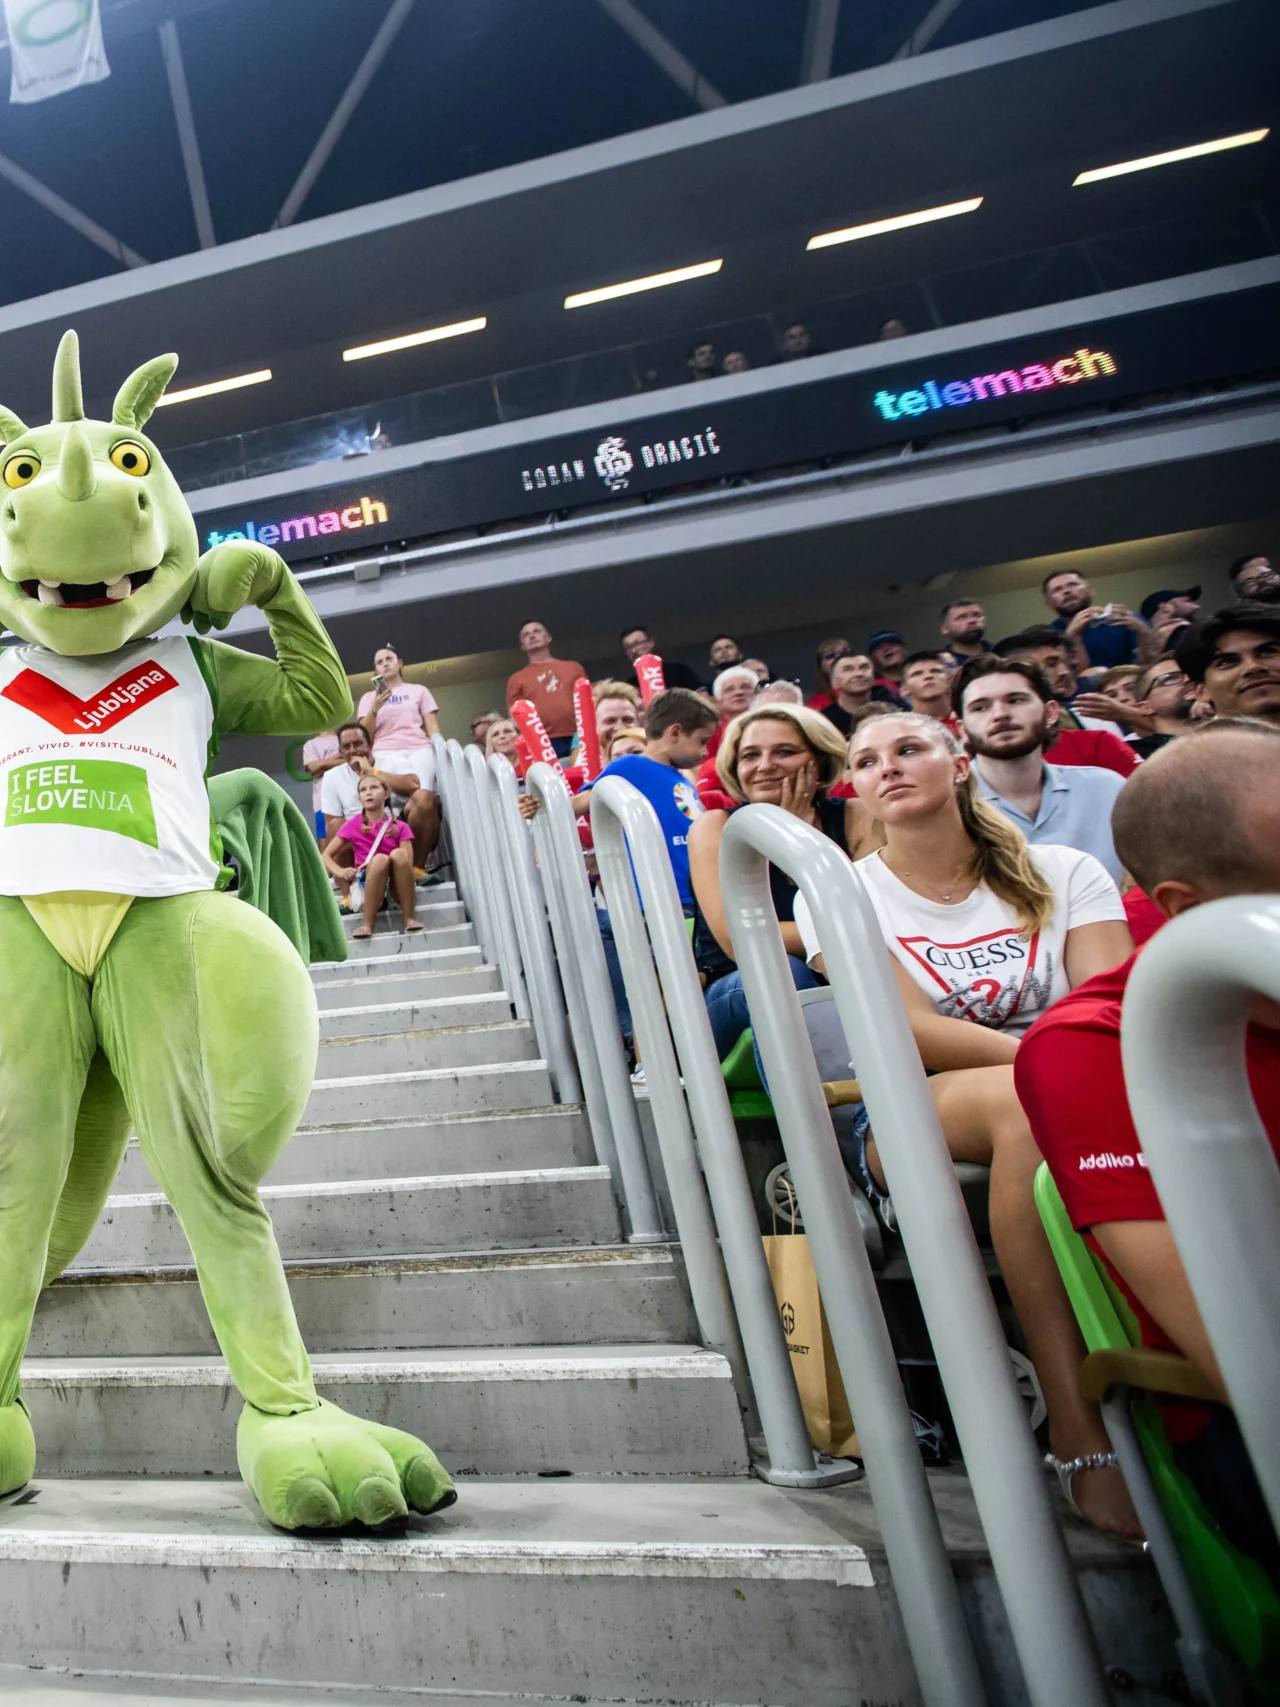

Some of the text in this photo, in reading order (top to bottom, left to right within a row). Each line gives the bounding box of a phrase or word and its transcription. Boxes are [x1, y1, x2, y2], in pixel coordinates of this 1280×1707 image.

[874, 349, 1117, 420] telemach
[73, 669, 165, 730] Ljubljana
[38, 741, 74, 751] VIVID.
[80, 741, 178, 769] #VISITLJUBLJANA
[11, 764, 84, 795] I FEEL
[10, 788, 135, 818] SLOVENIA
[926, 937, 1025, 970] GUESS
[1079, 1152, 1135, 1171] Addiko
